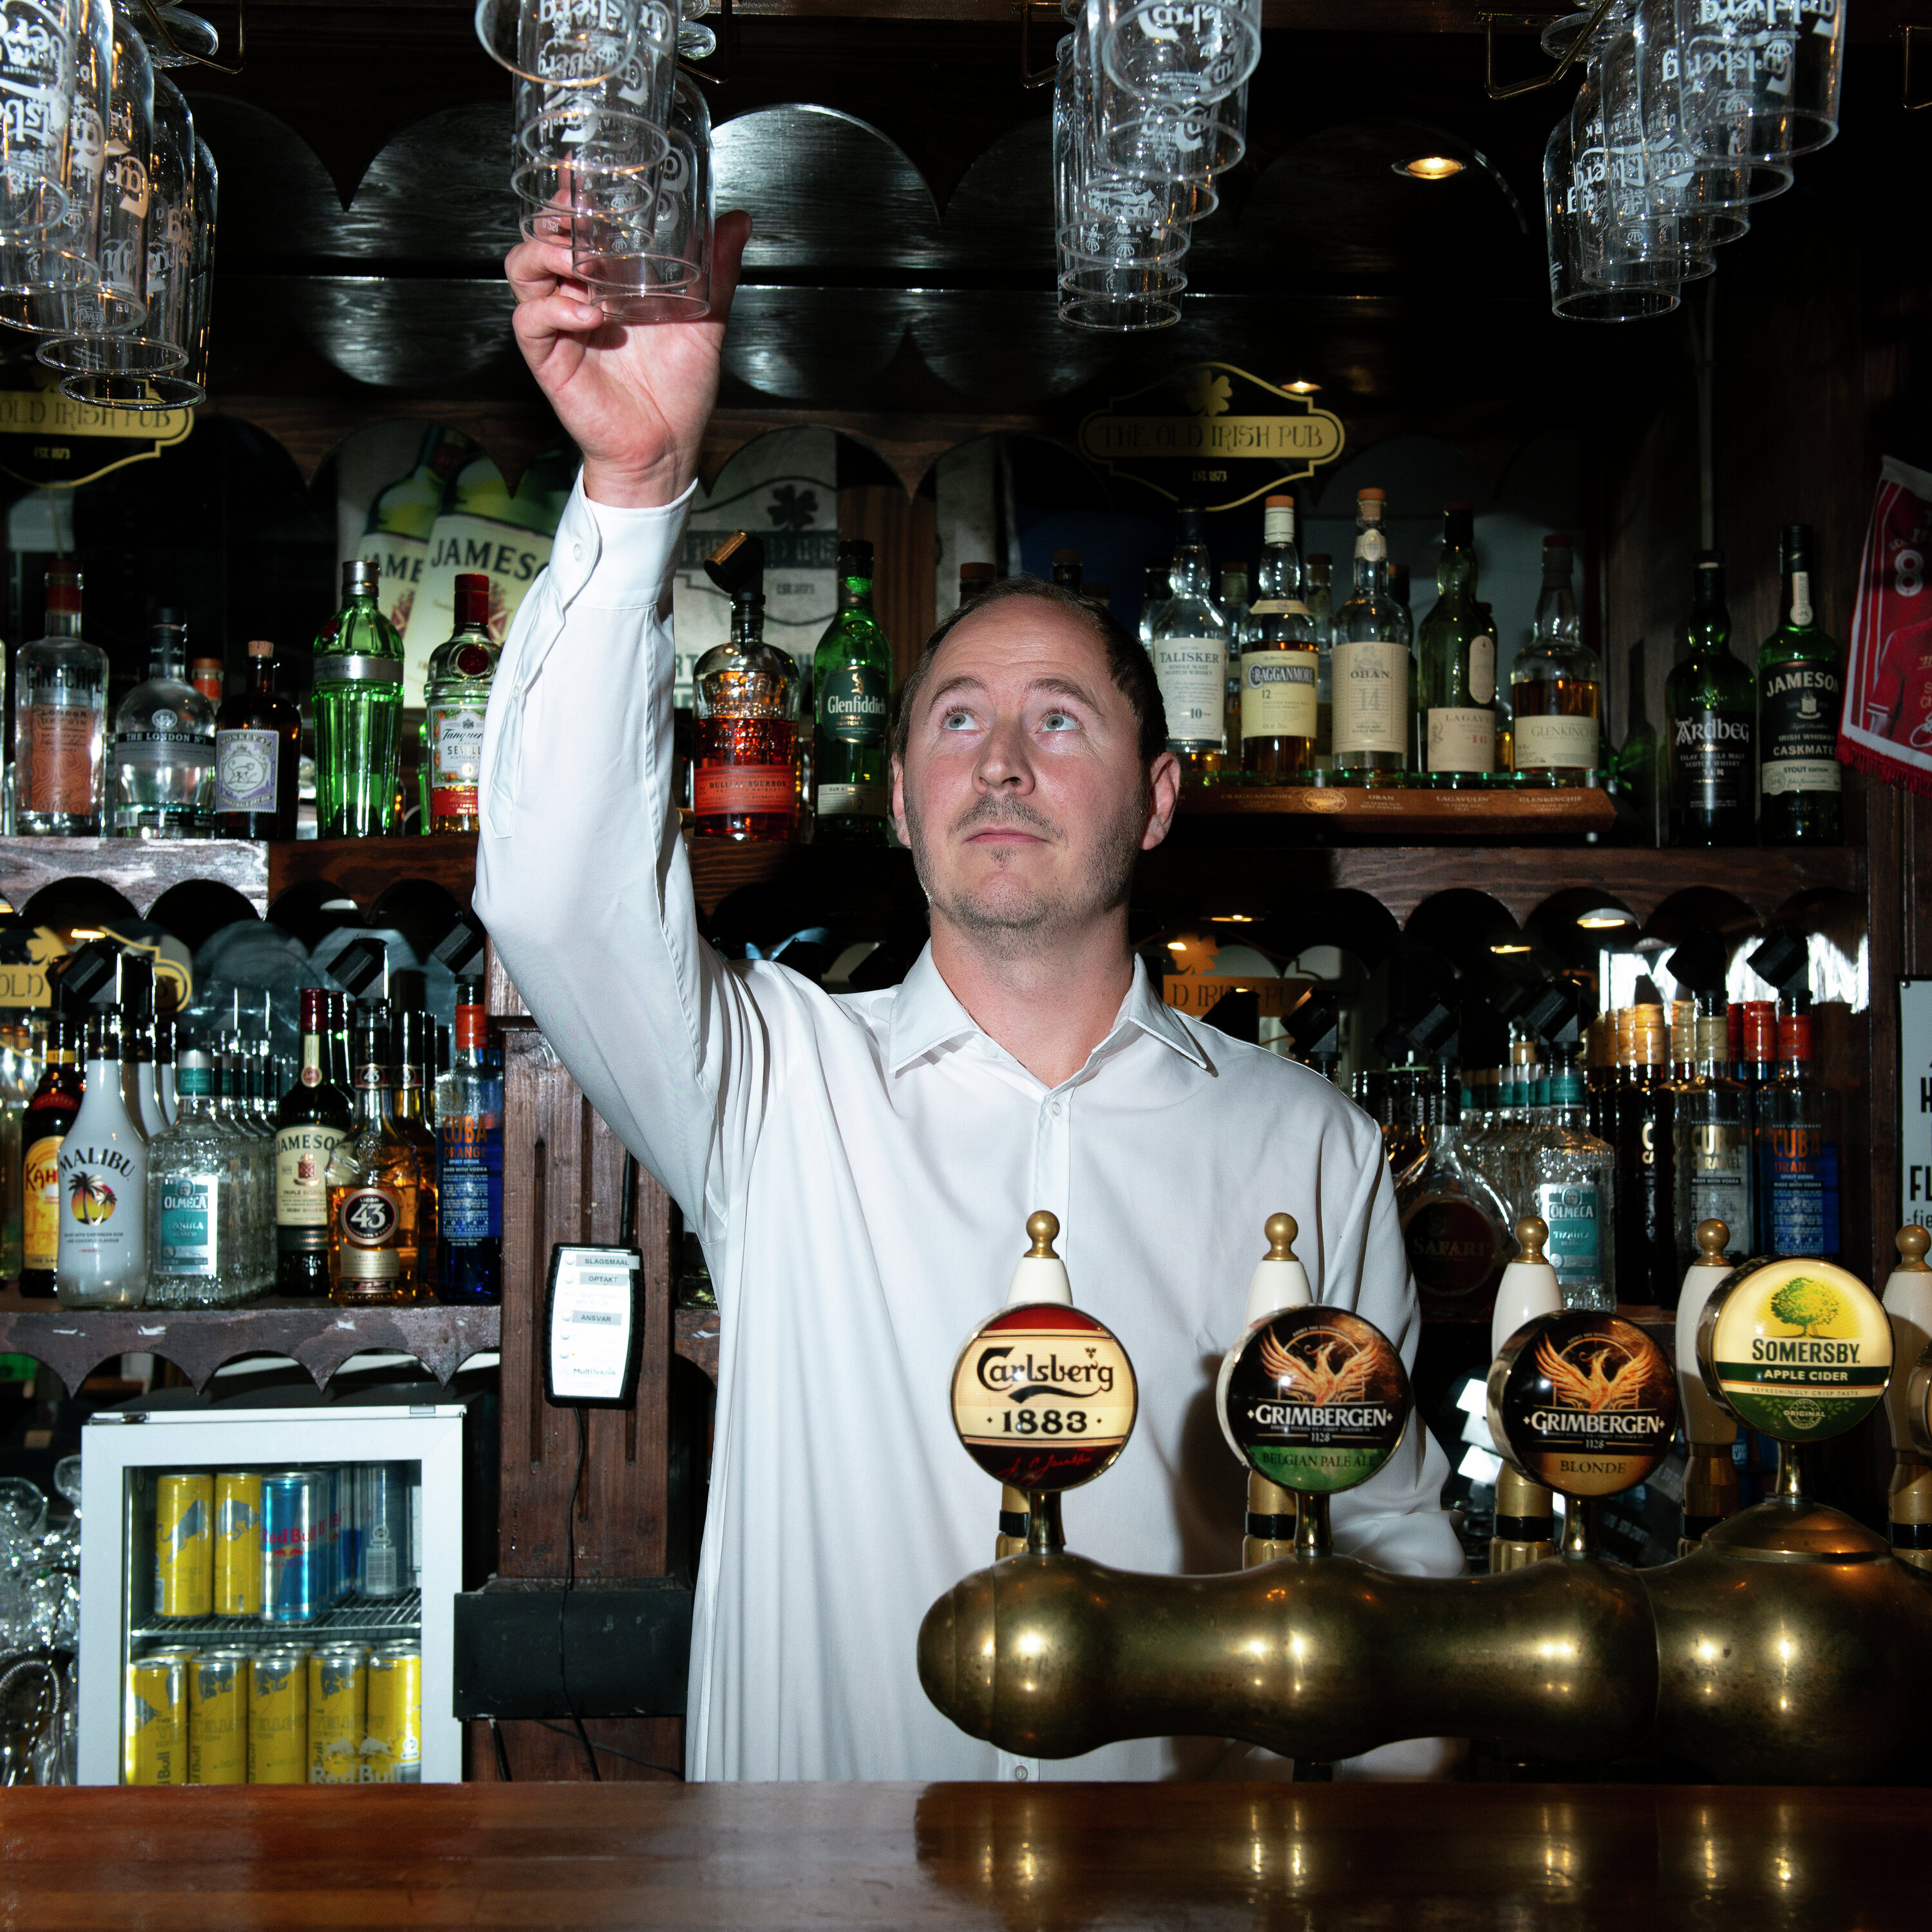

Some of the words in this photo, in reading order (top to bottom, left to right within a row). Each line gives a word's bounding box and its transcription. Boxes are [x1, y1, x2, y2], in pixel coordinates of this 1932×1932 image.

[1104, 424, 1149, 448] THE
[1156, 424, 1202, 448] OLD
[1211, 424, 1269, 452] IRISH
[1278, 424, 1323, 448] PUB
[1160, 652, 1218, 663] TALISKER
[1248, 663, 1314, 688] CRAGGANMORE
[1766, 671, 1839, 697] JAMESON
[828, 696, 886, 714] Glenfiddich
[1190, 708, 1202, 719] 10
[127, 733, 142, 741] THE
[146, 732, 190, 743] LONDON
[442, 728, 483, 741] Tanquer
[1778, 734, 1801, 742] IRISH
[448, 746, 481, 755] SEVILL
[1773, 744, 1835, 757] CASKMATE
[710, 781, 743, 789] BULLEIT
[364, 1070, 380, 1083] 43
[443, 1115, 488, 1143] CUBA
[1691, 1124, 1739, 1155] CUBA
[1773, 1130, 1821, 1159] CUBA
[444, 1146, 487, 1158] ORANGE
[59, 1147, 135, 1178] MALIBU
[1774, 1161, 1821, 1173] ORANGE
[25, 1162, 57, 1191] KAH
[164, 1196, 207, 1209] OLMECA
[350, 1203, 386, 1229] 43
[1550, 1205, 1594, 1218] OLMECA
[1412, 1237, 1485, 1256] SAFARI
[585, 1257, 629, 1266] SLAGSMAAL
[589, 1275, 618, 1283] OPTAKT
[581, 1314, 611, 1322] ANSVAR
[574, 1367, 617, 1376] MultiTeknik
[977, 1346, 1113, 1392] Carlsberg
[1763, 1368, 1806, 1380] APPLE
[1808, 1371, 1848, 1381] CIDER
[1752, 1387, 1808, 1396] REFRESHINGLY
[1002, 1408, 1087, 1434] 1883
[1255, 1404, 1387, 1427] GRIMBERGEN
[1531, 1410, 1660, 1434] GRIMBERGEN
[1311, 1432, 1331, 1443] 1128
[1586, 1438, 1605, 1450] 1128
[1263, 1452, 1318, 1466] BELGIAN
[1321, 1454, 1351, 1467] PALE
[1353, 1455, 1376, 1467] ALE
[1560, 1459, 1627, 1474] BLONDE
[261, 1527, 287, 1543] Red
[310, 1765, 355, 1785] Red
[358, 1763, 402, 1784] Bull
